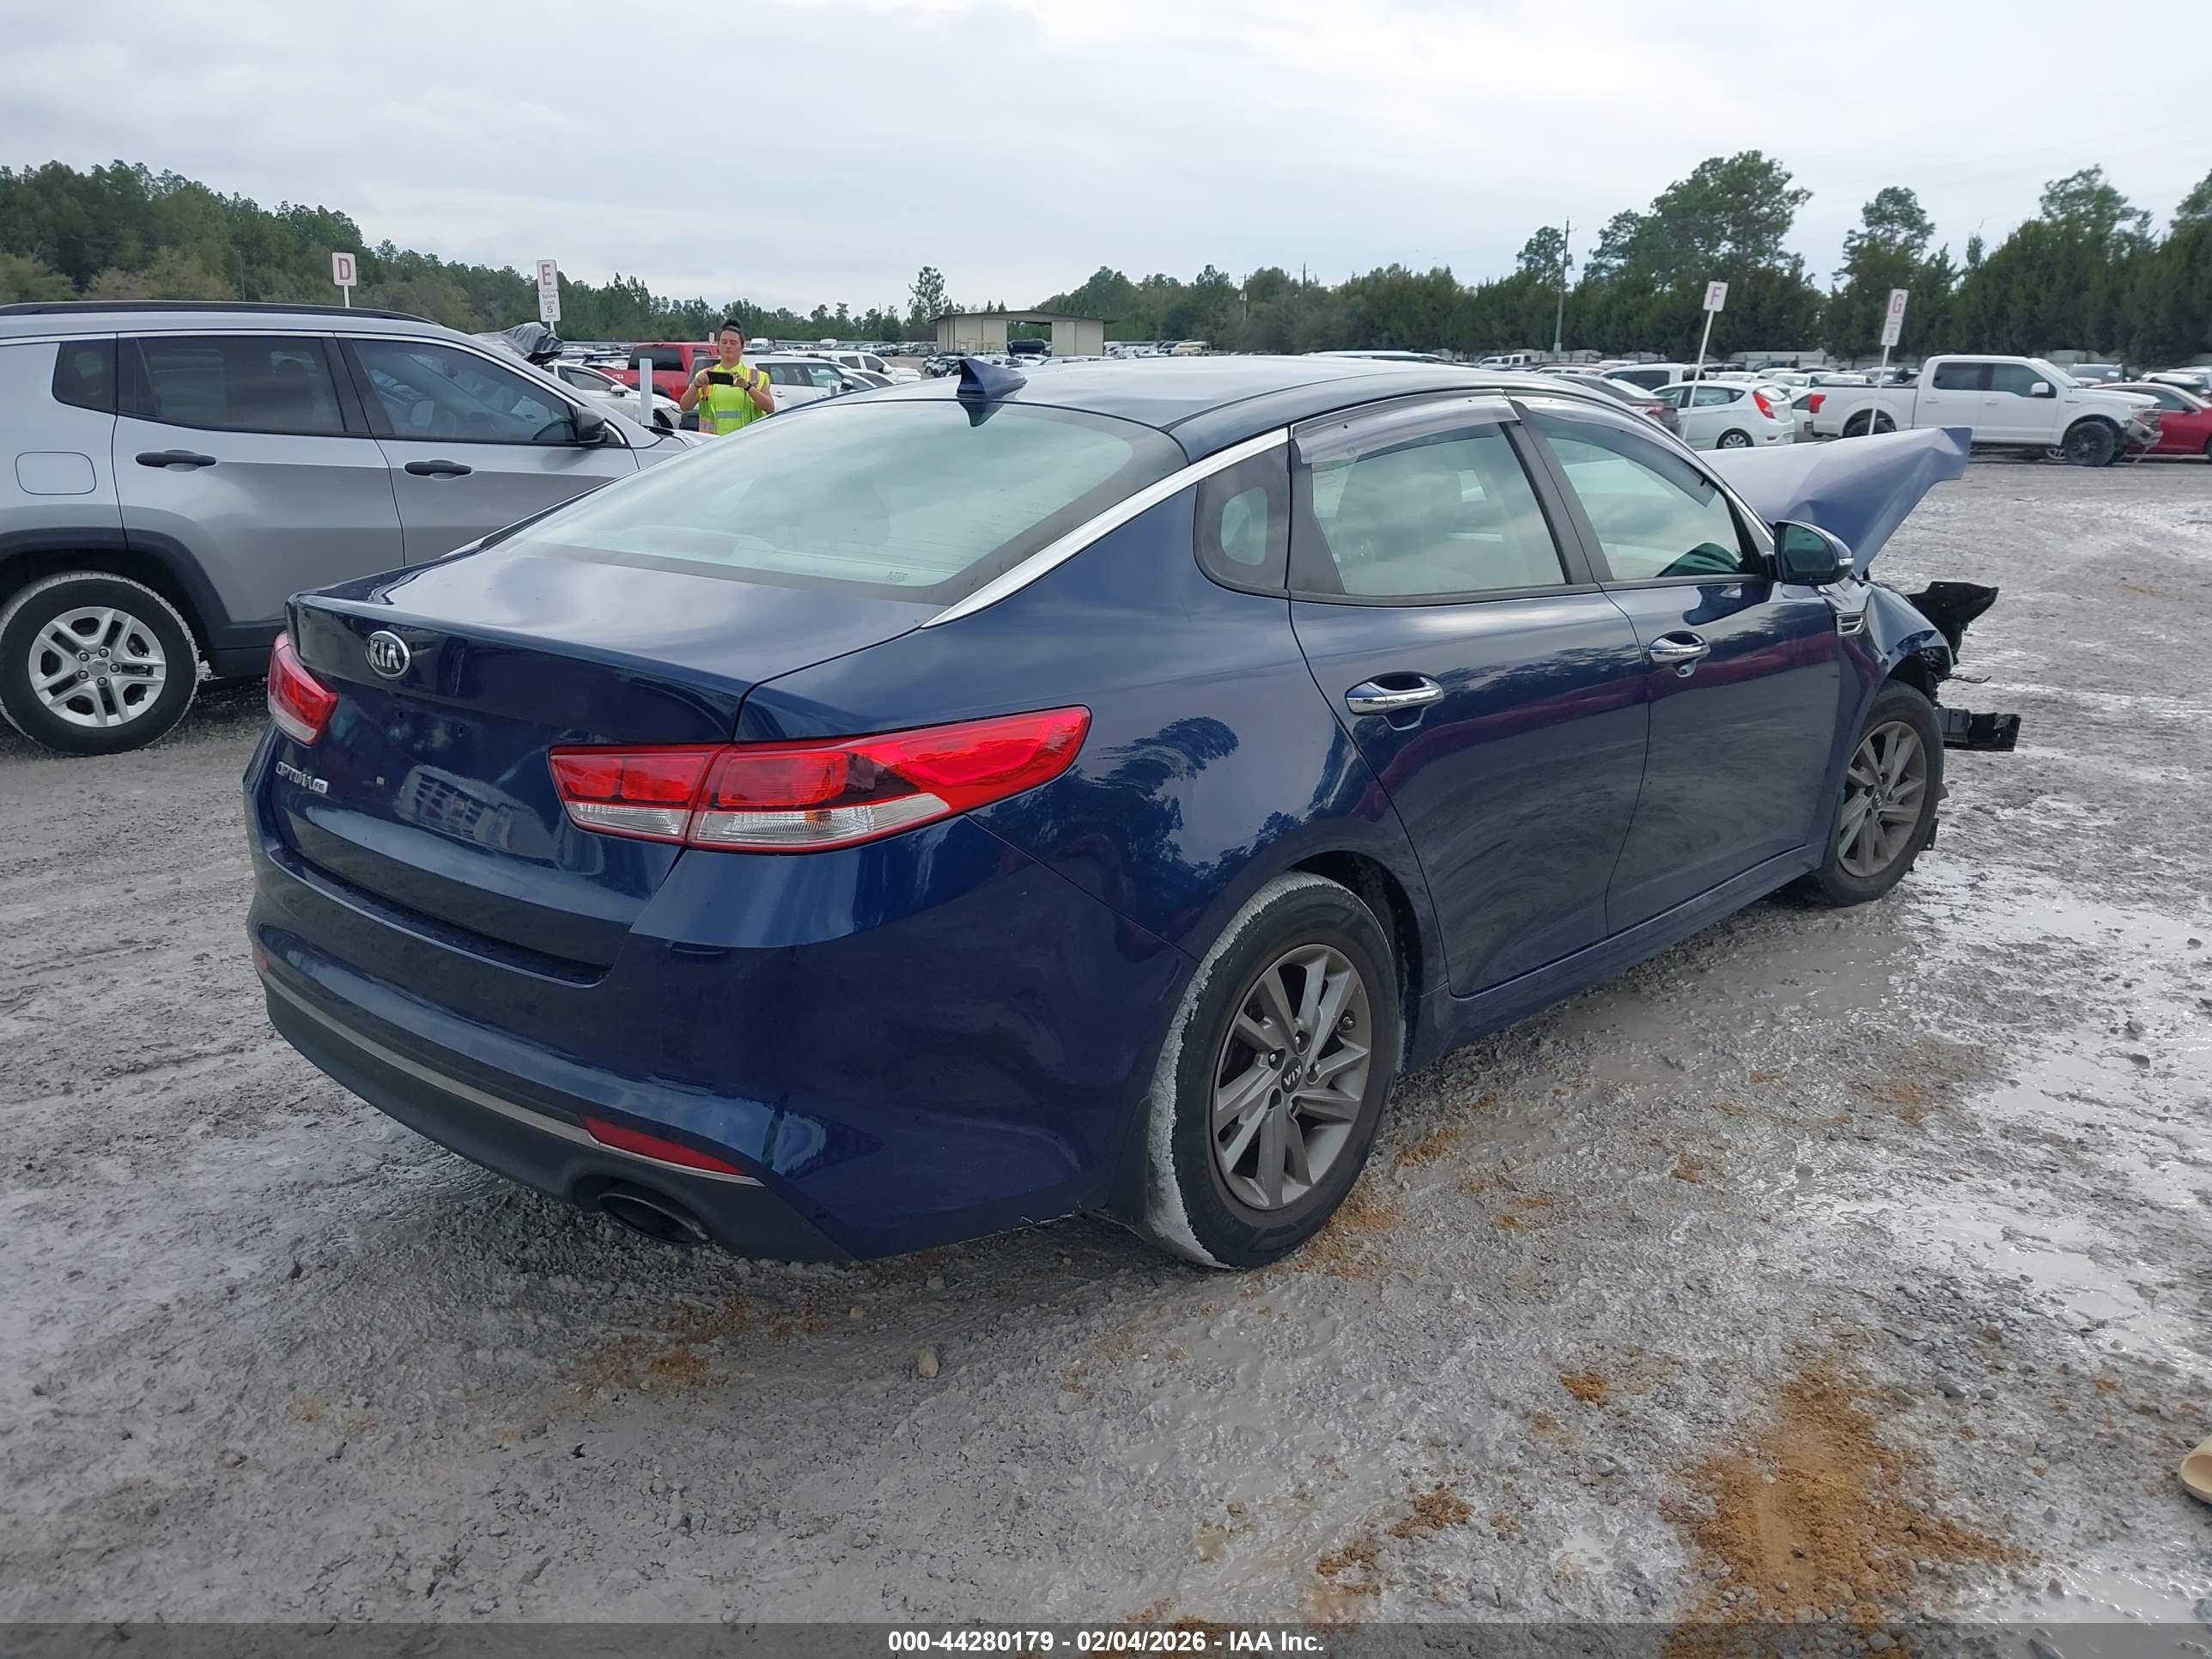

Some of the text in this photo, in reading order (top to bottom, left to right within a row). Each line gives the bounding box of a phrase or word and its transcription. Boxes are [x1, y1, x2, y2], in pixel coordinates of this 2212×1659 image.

[337, 258, 352, 281] D
[541, 264, 552, 286] E
[1710, 286, 1723, 306] F
[1892, 293, 1905, 314] G
[546, 305, 554, 314] 5
[369, 639, 401, 670] KIA
[1283, 1064, 1302, 1086] KIA
